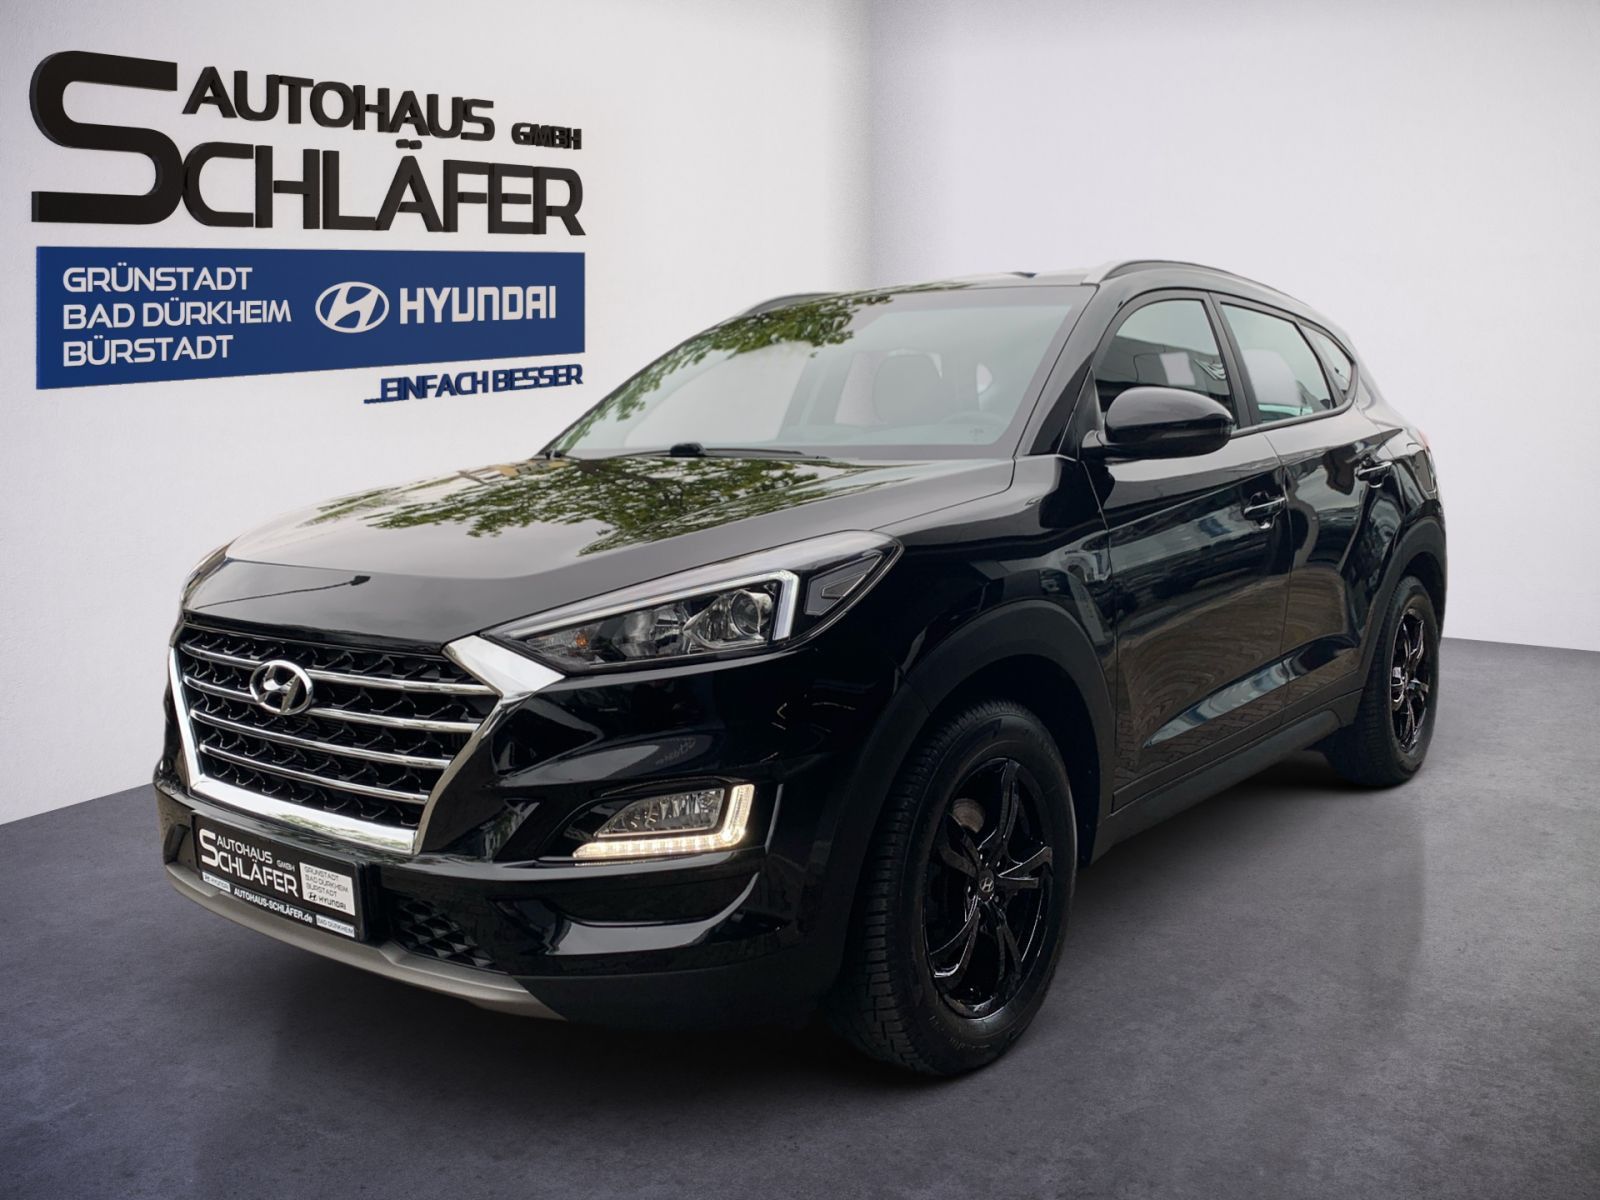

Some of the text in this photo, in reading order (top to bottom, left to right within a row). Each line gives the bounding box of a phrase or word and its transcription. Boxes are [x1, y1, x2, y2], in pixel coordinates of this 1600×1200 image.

[182, 66, 582, 150] AUTOHAUS GMBH
[29, 50, 587, 236] SCHLÄFER
[62, 261, 253, 293] GRÜNSTADT
[63, 297, 292, 330] BAD DÜRKHEIM
[399, 285, 557, 325] HYUNDAI
[63, 334, 234, 367] BÜRSTADT
[492, 363, 584, 393] BESSER
[199, 828, 299, 898] SCHLÄFER
[217, 835, 273, 864] AUTOHAUS
